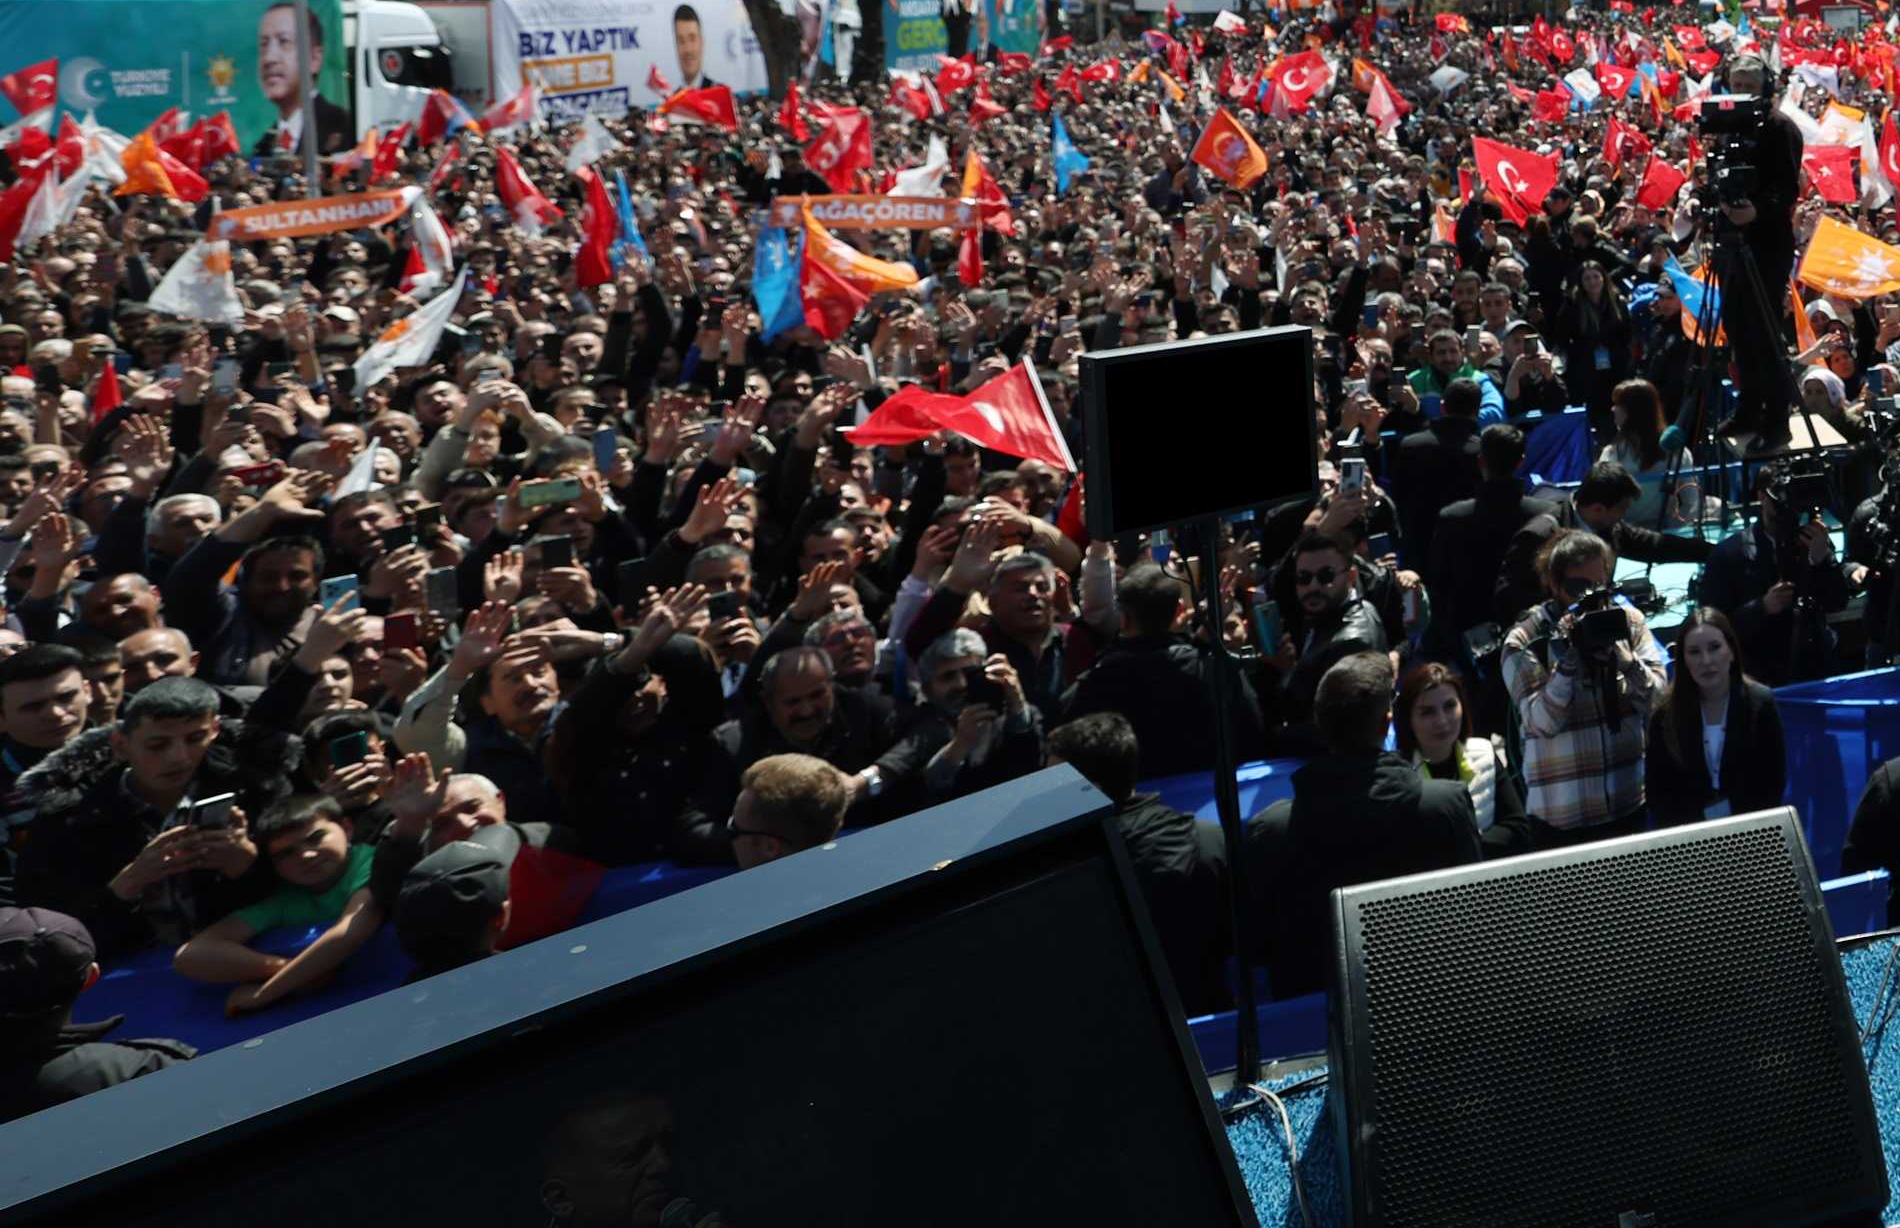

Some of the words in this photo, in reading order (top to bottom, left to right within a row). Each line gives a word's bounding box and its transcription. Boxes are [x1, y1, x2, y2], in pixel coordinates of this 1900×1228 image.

[519, 31, 556, 58] BİZ
[562, 26, 641, 53] YAPTIK
[244, 198, 396, 234] SULTANHANI
[811, 199, 945, 225] AĞAÇÖREN
